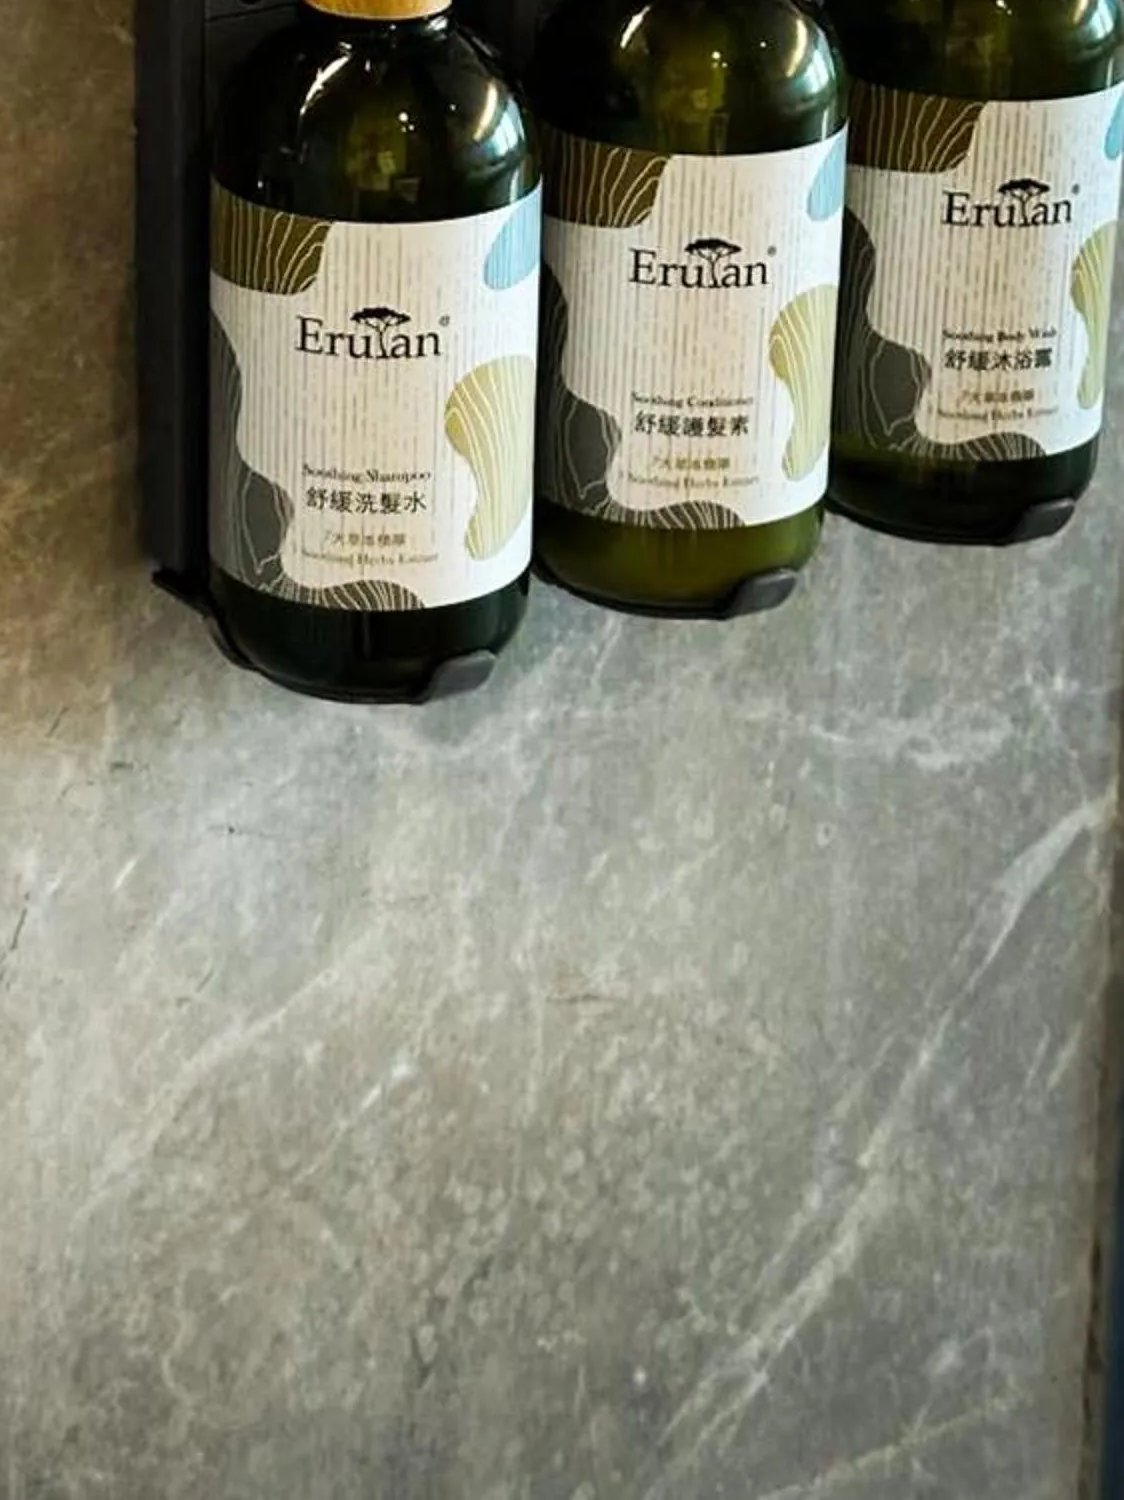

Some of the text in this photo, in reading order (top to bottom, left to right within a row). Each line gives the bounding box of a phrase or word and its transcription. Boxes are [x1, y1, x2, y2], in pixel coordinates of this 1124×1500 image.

[306, 487, 427, 514] 舒緩洗髮水
